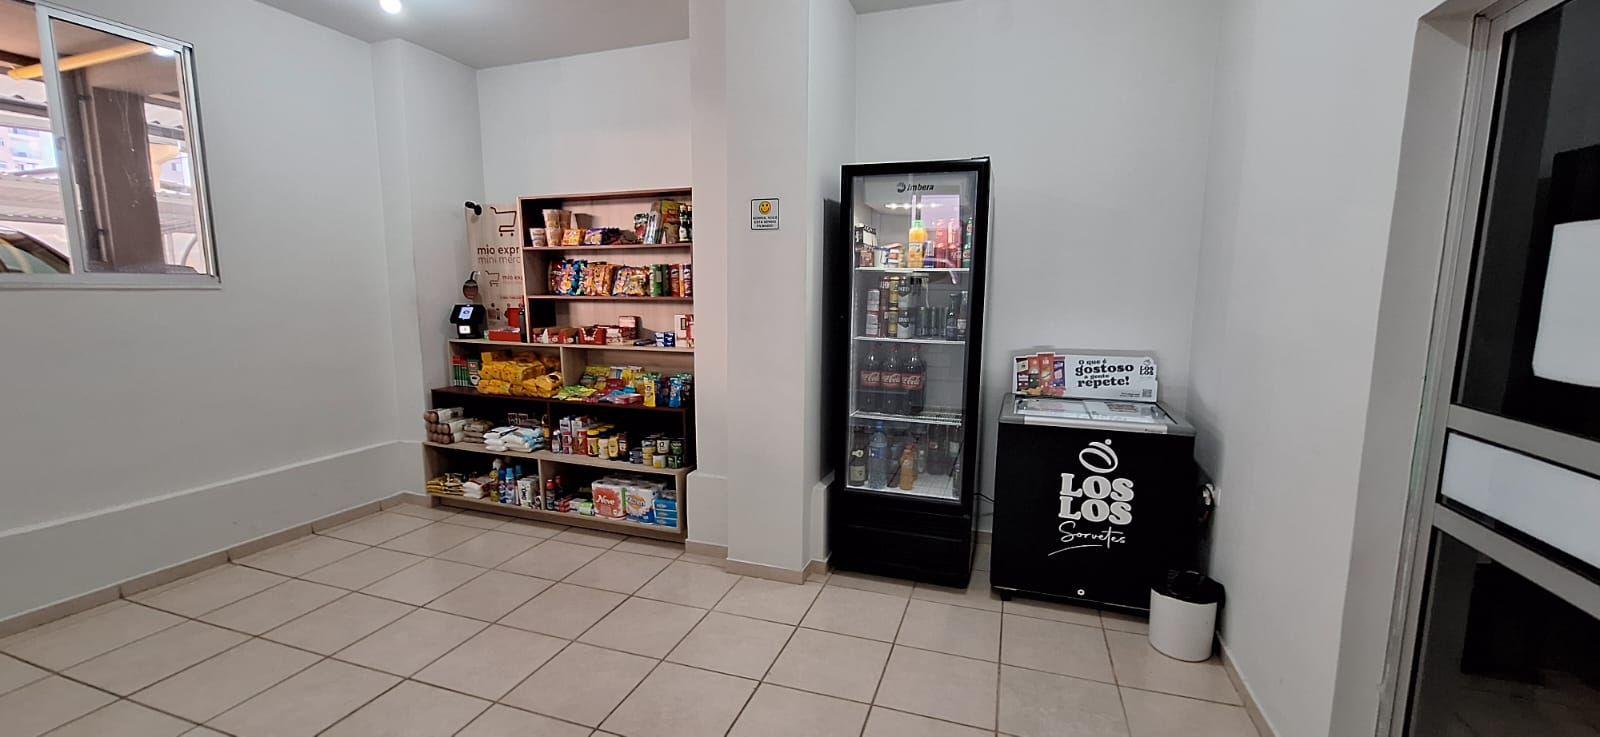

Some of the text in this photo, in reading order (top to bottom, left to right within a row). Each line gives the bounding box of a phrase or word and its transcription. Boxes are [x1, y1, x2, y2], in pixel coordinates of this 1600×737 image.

[477, 244, 495, 255] mio
[478, 256, 497, 264] mini
[1075, 364, 1134, 377] gostoso
[1078, 376, 1130, 388] repete!
[1059, 472, 1134, 502] LOS
[1058, 495, 1133, 525] LOS
[1058, 520, 1126, 549] Sorvetes
